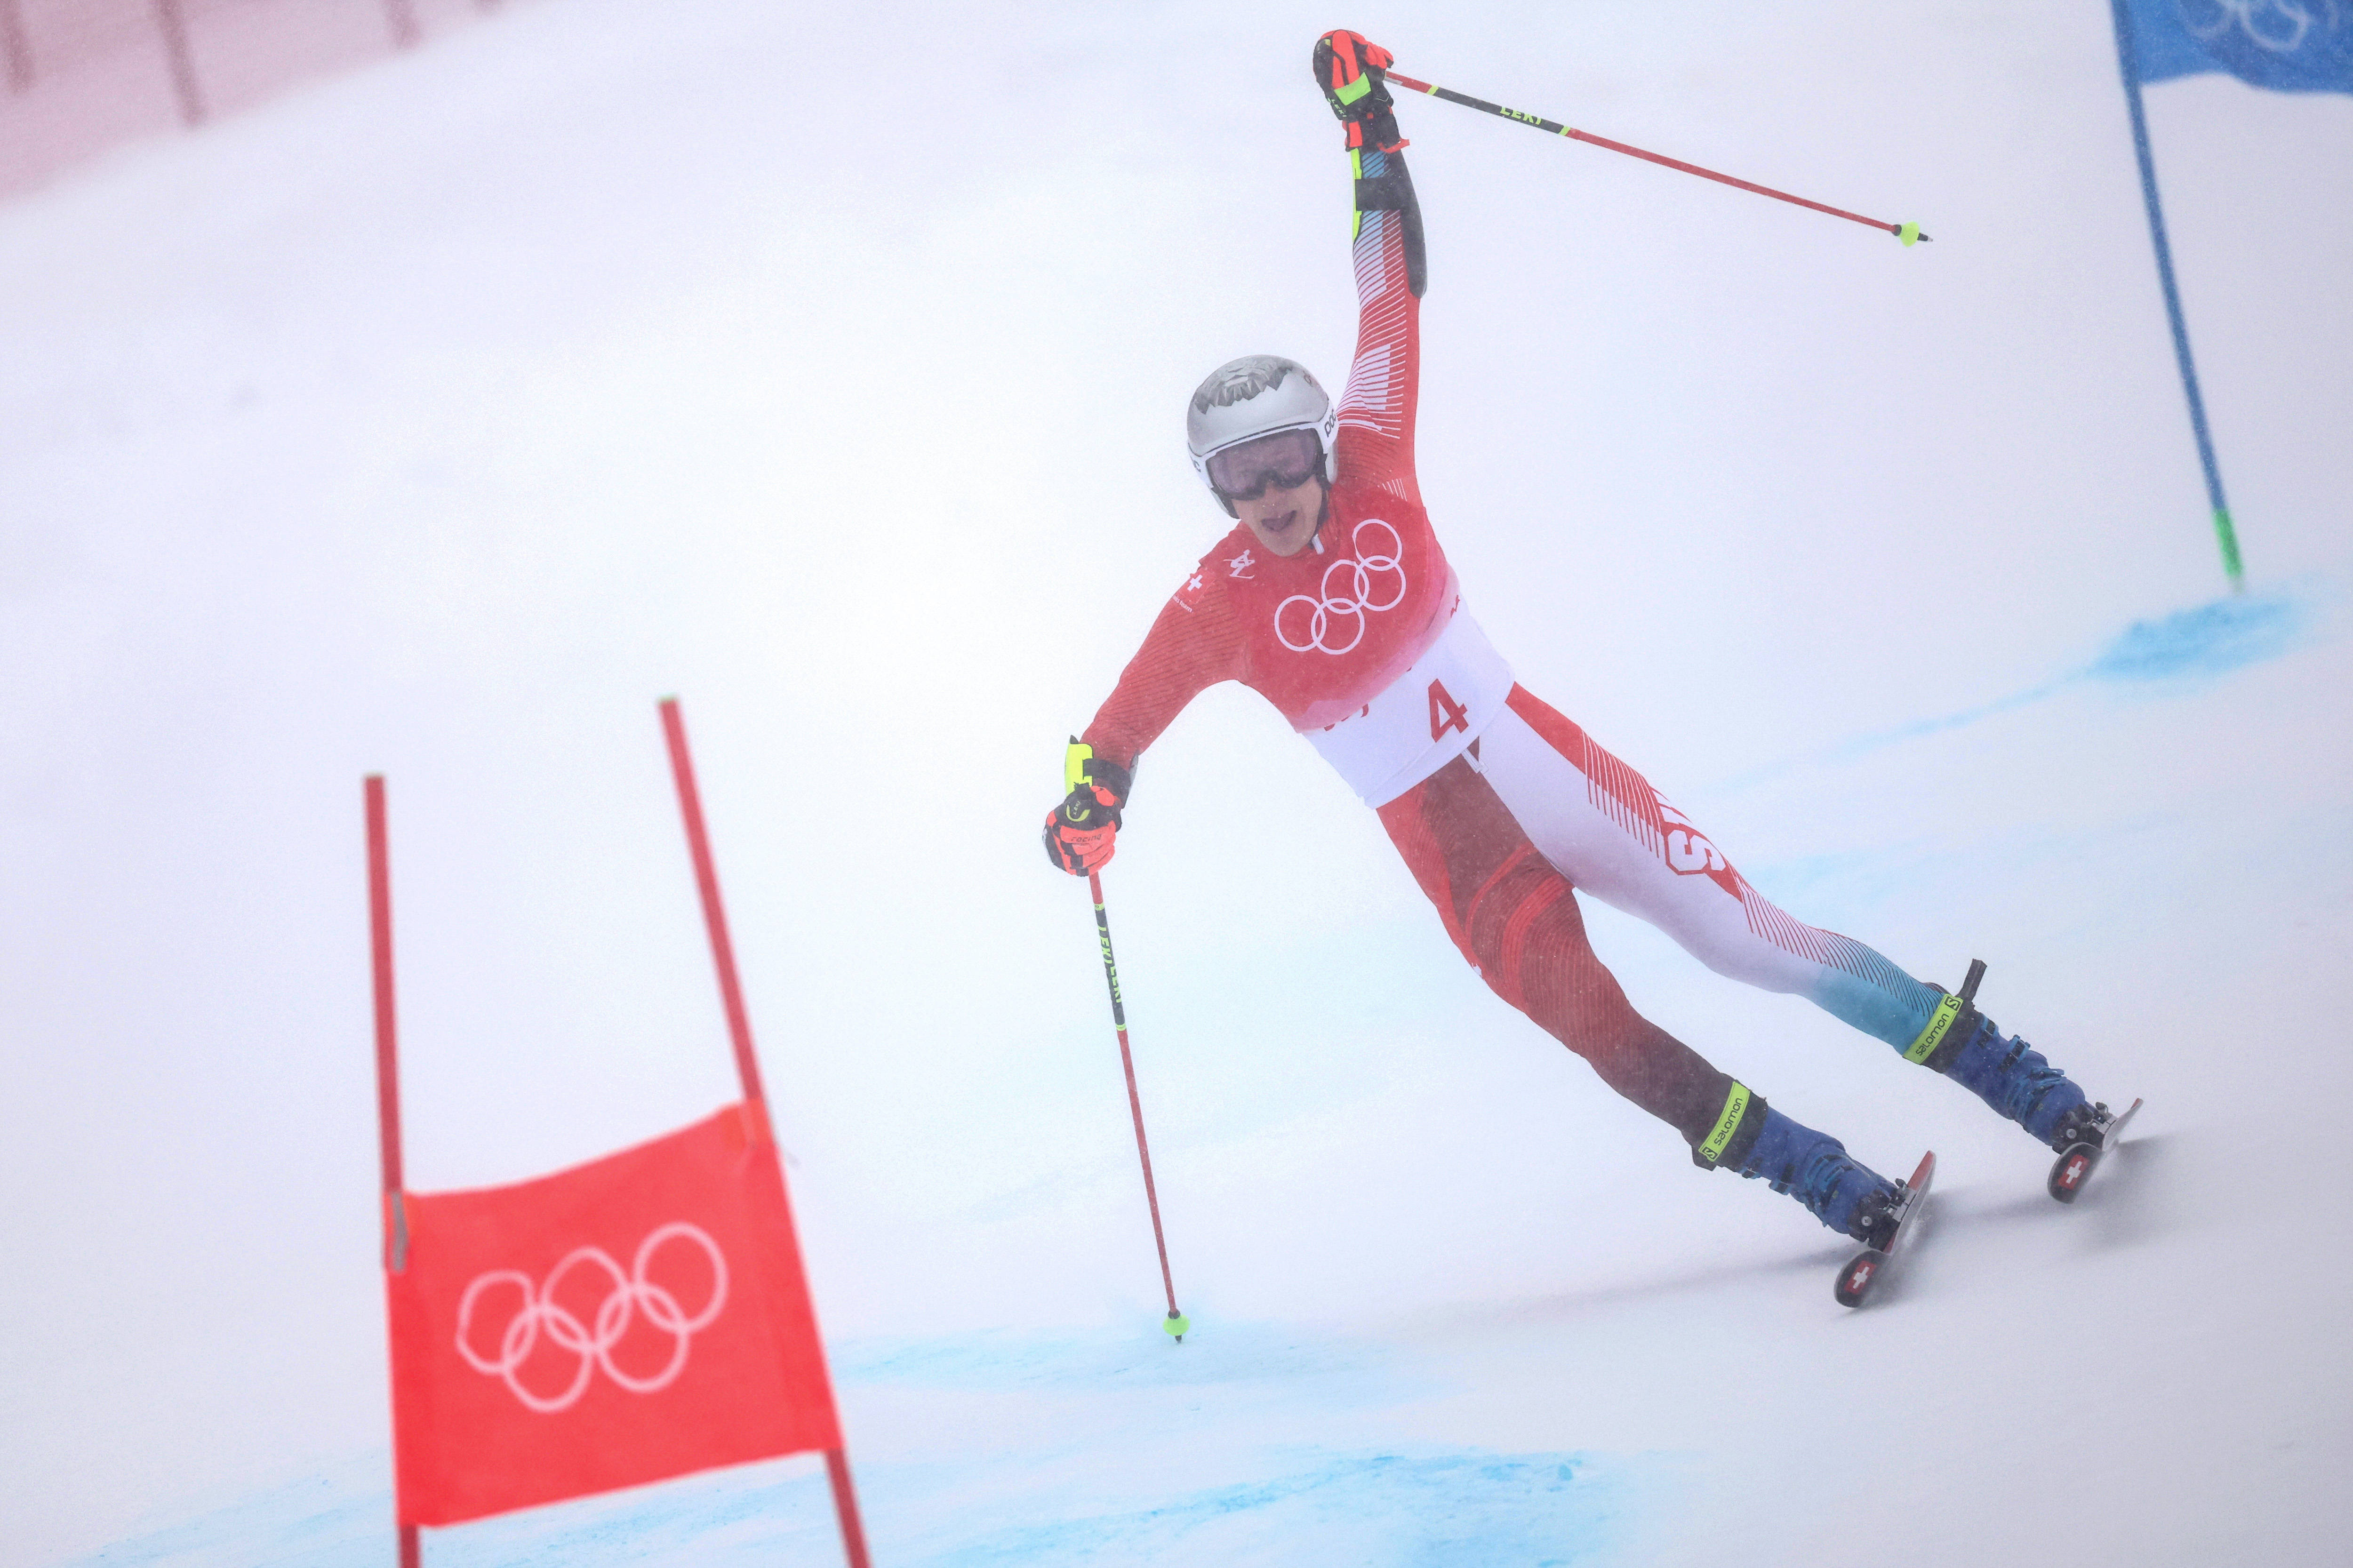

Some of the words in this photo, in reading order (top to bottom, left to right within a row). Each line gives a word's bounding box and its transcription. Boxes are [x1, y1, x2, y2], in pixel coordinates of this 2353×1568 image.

[1331, 99, 1347, 117] LEKI
[1500, 107, 1541, 125] LEKI
[1324, 408, 1336, 438] POC
[1428, 678, 1469, 743] 4
[1915, 1013, 1949, 1056] salomon
[1714, 1097, 1743, 1146] salomon
